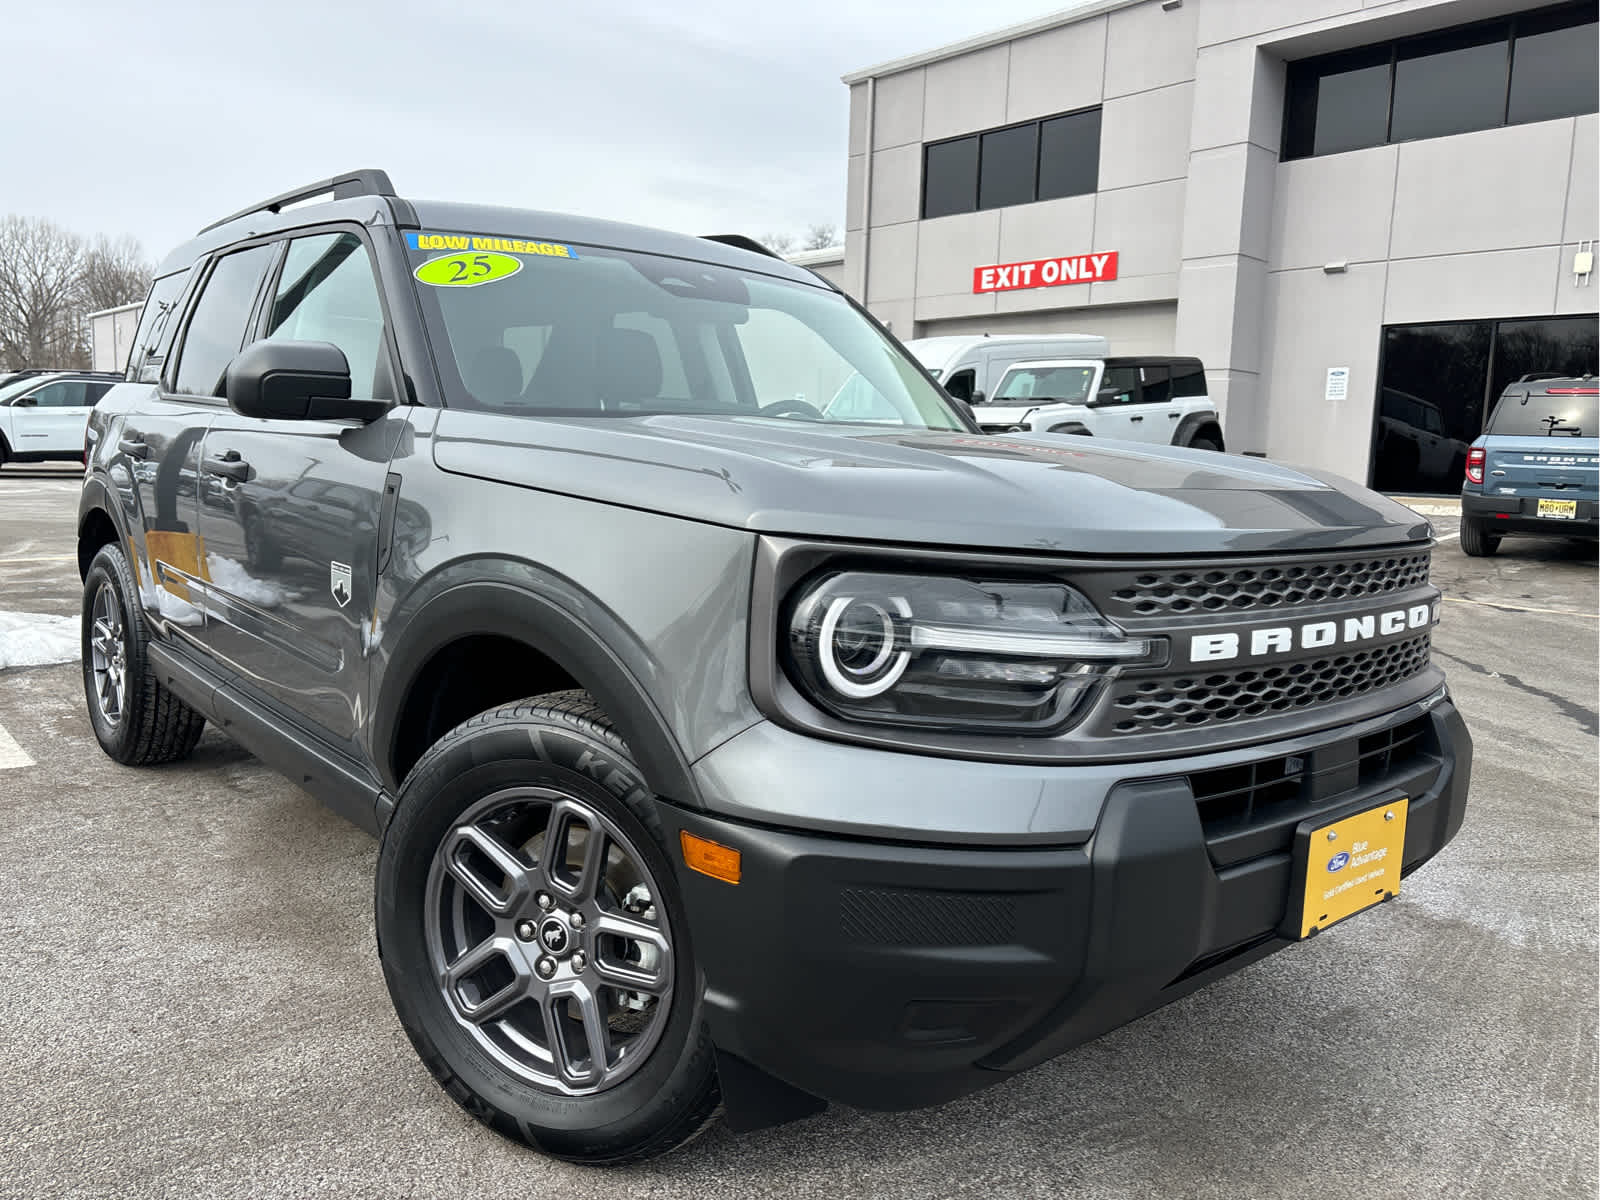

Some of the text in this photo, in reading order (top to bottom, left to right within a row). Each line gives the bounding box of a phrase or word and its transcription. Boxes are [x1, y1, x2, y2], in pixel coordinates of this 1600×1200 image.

[417, 234, 571, 258] LOW MILEAGE
[447, 255, 492, 283] 25
[980, 254, 1110, 290] EXIT ONLY
[1190, 604, 1429, 663] BRONCO
